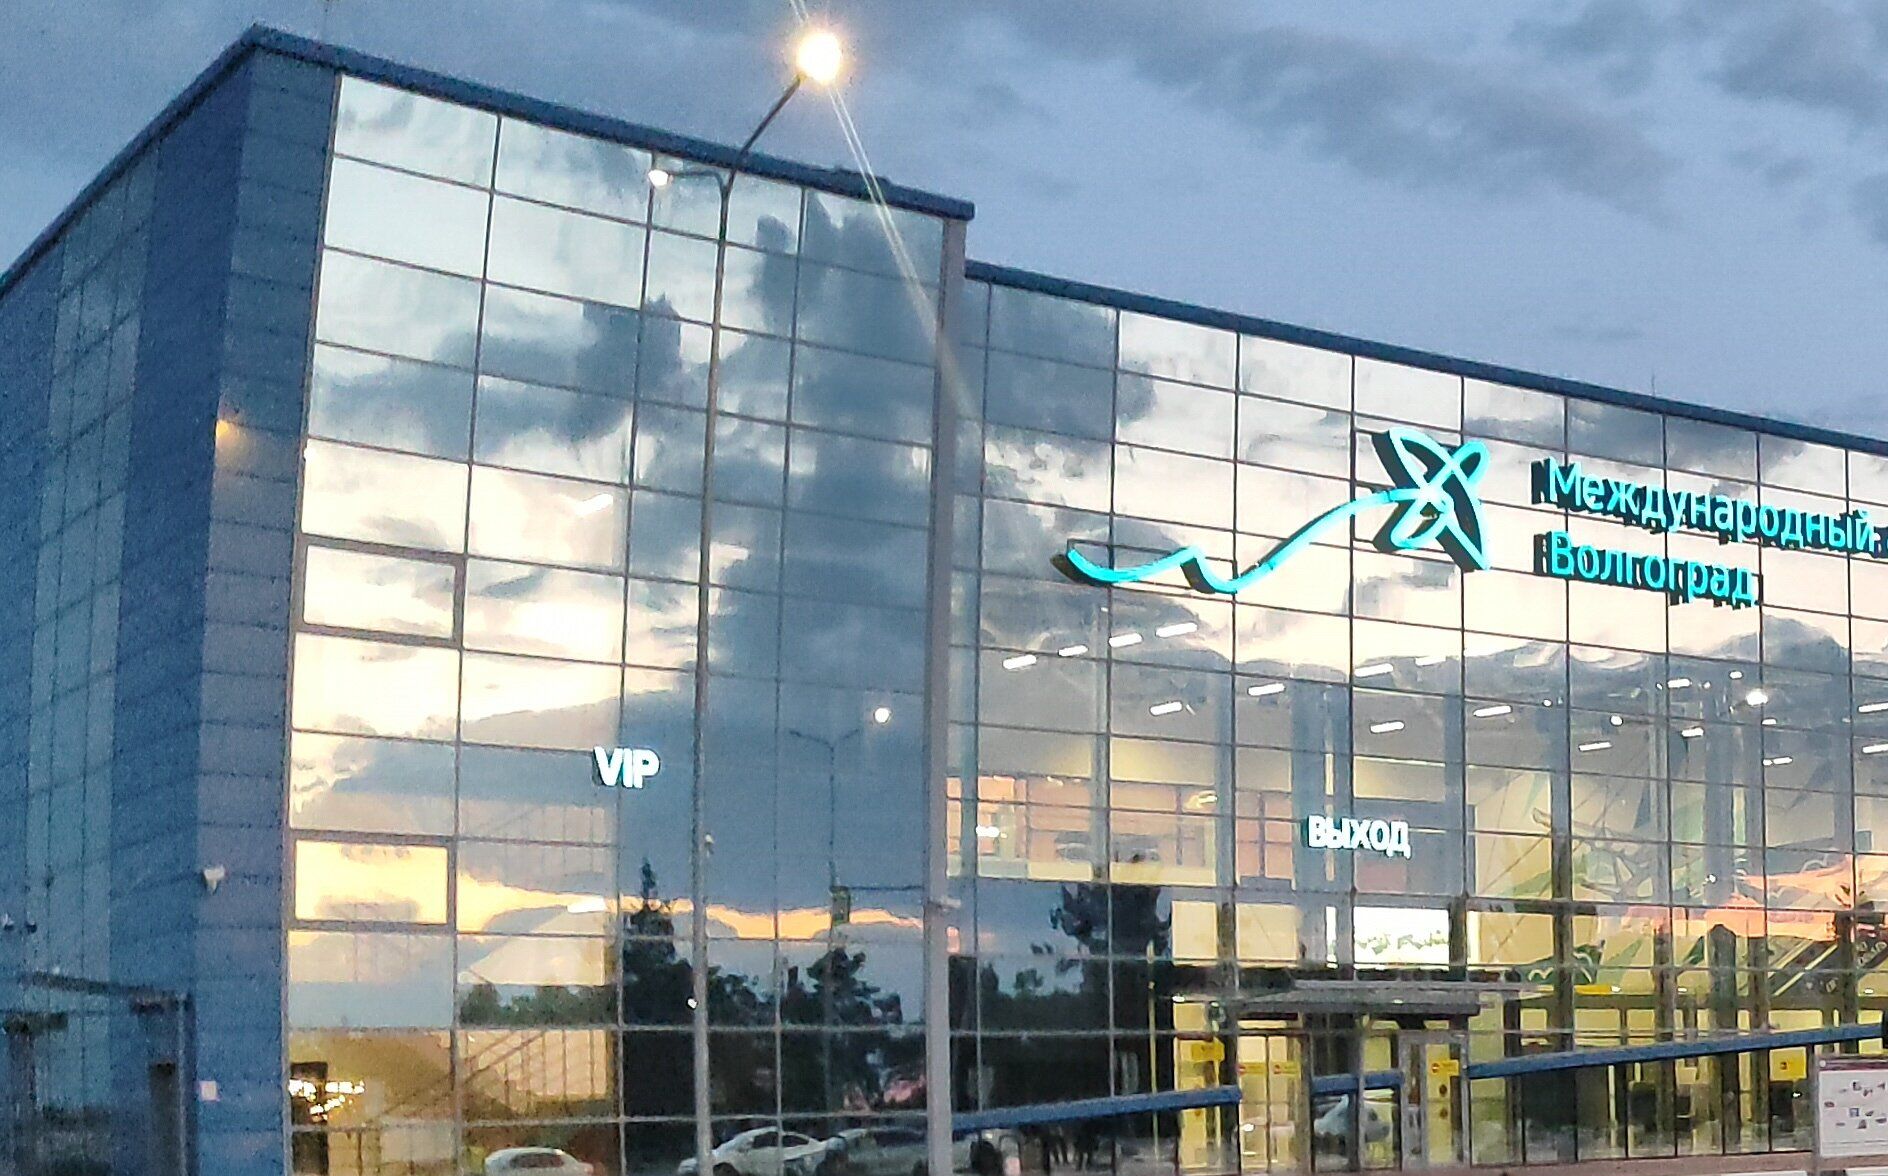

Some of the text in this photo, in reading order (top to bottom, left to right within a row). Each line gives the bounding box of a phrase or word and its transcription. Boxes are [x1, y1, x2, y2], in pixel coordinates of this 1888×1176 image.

[1549, 456, 1874, 550] Международный
[1550, 530, 1761, 607] Волгоград
[593, 746, 660, 789] VIP
[1308, 815, 1412, 860] ВЫХОД
